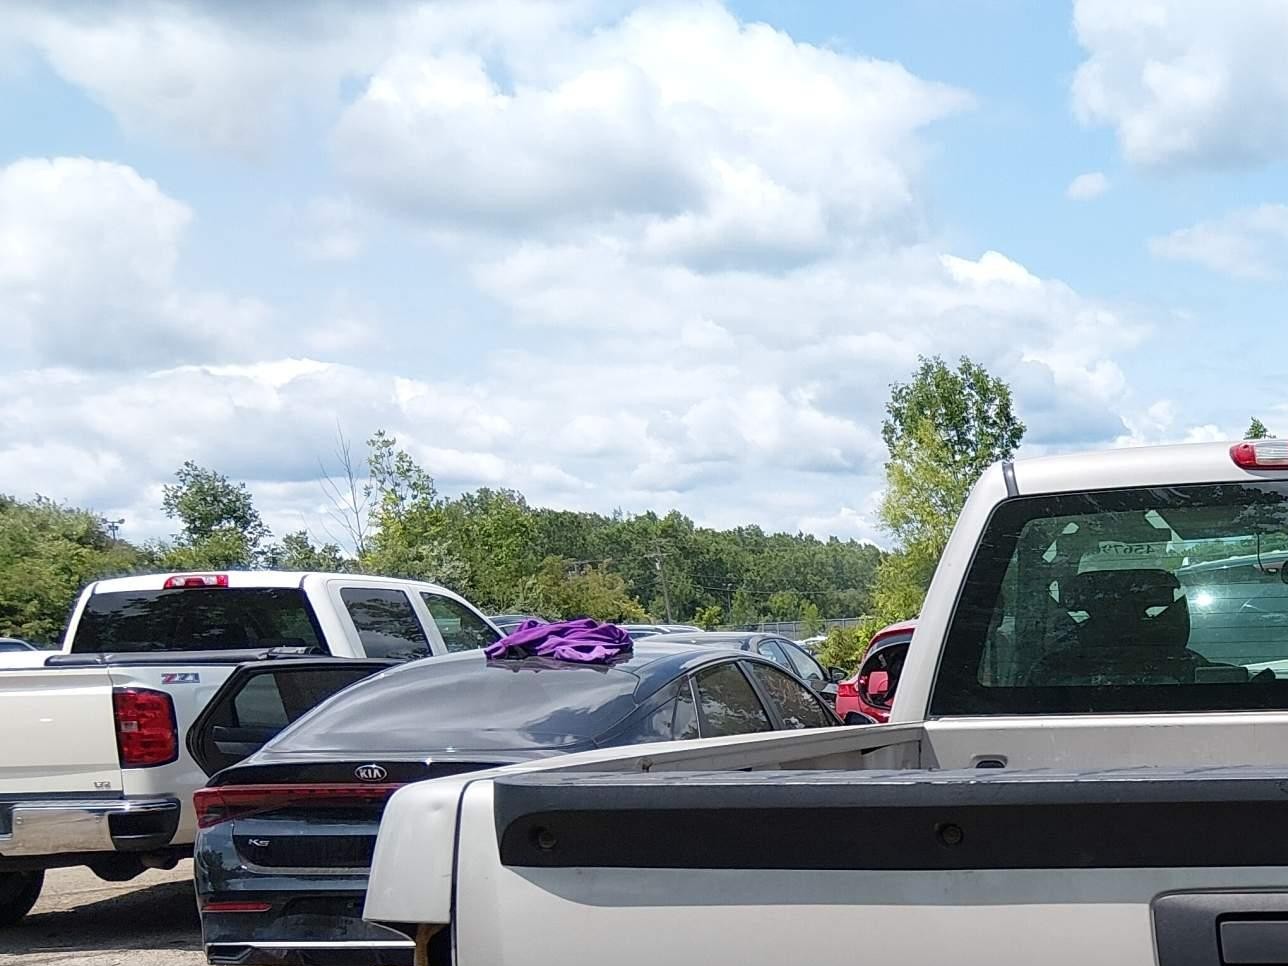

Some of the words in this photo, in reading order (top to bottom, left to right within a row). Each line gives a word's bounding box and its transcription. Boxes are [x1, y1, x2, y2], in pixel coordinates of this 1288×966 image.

[161, 672, 200, 684] Z71
[359, 768, 383, 780] KIA
[248, 838, 271, 847] K5
